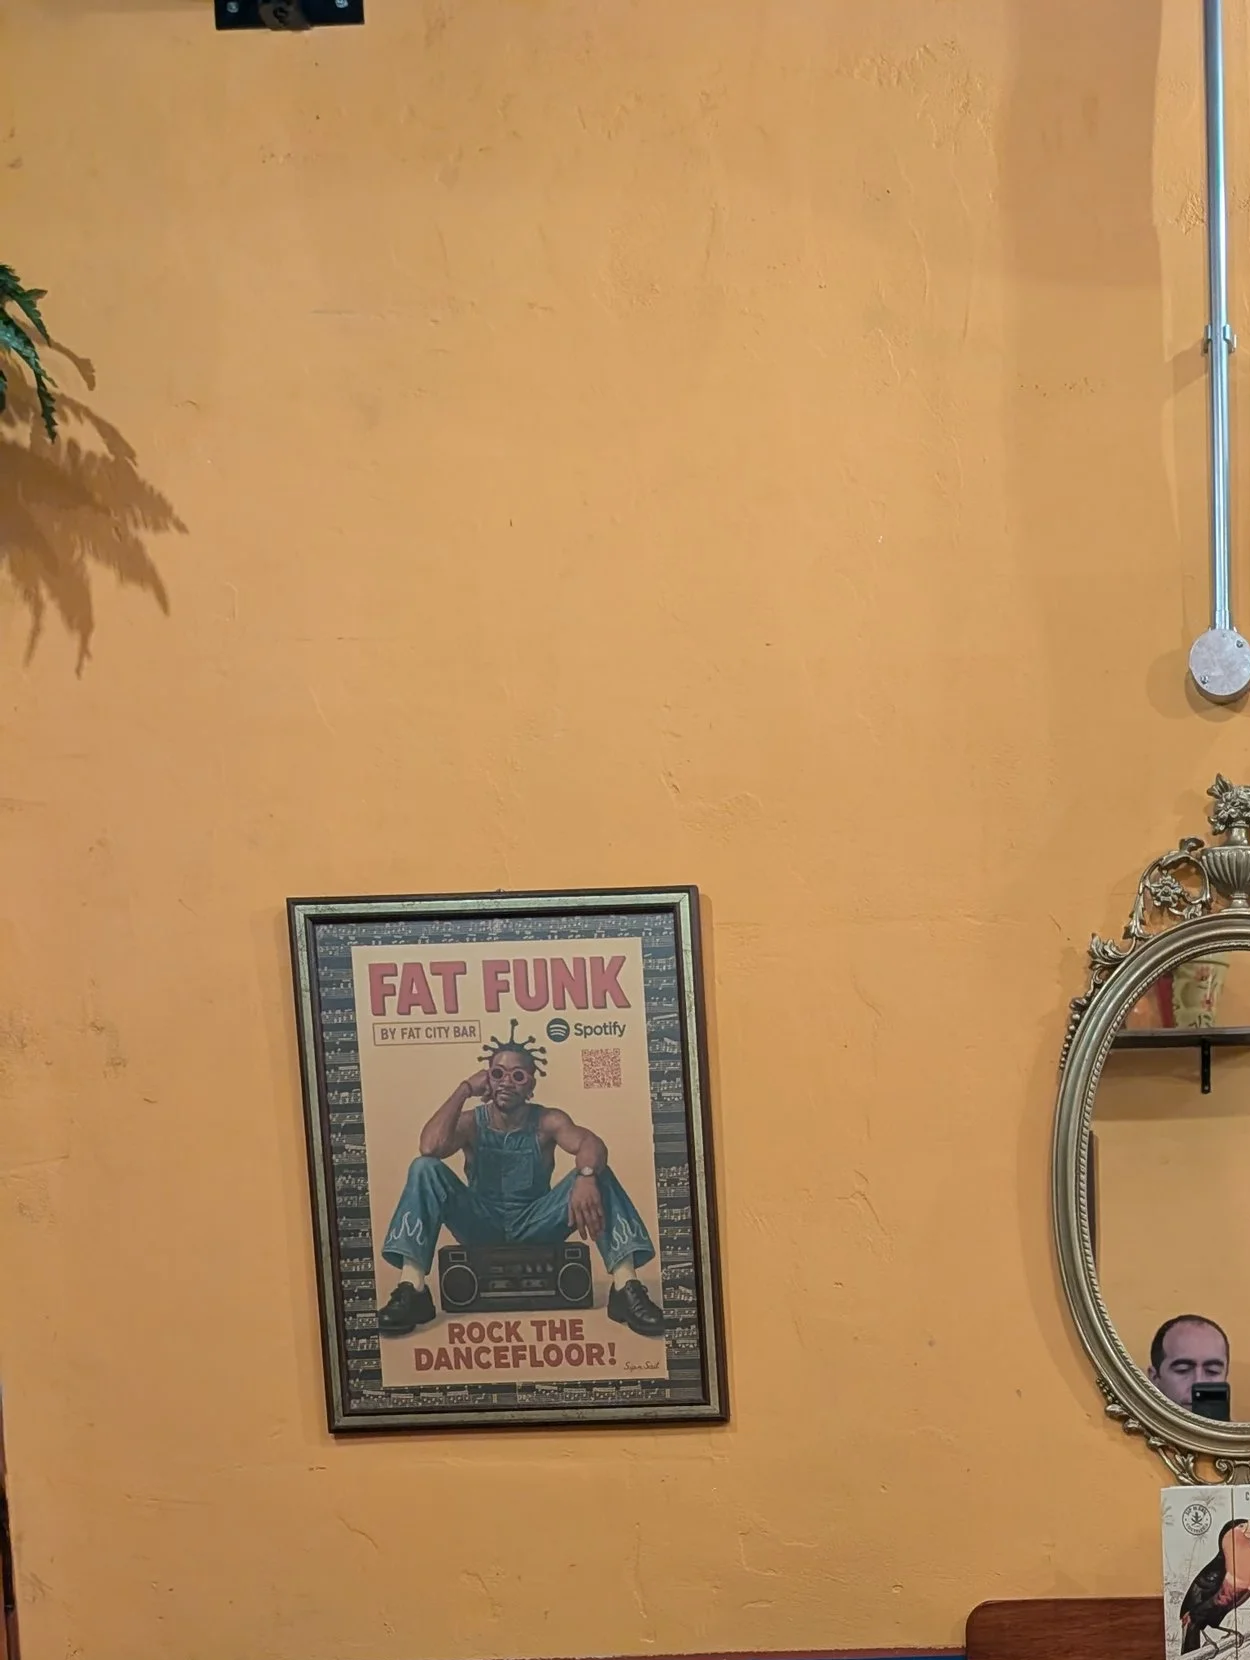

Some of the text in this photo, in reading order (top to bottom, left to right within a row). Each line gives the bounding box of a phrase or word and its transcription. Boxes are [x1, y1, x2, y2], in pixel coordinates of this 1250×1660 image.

[368, 956, 631, 1016] FAT FUNK
[380, 1025, 476, 1041] BY FAT CITY BAR
[574, 1021, 626, 1039] Spotify
[447, 1318, 585, 1345] ROCK THE
[414, 1342, 617, 1371] DANCEFLOOR!
